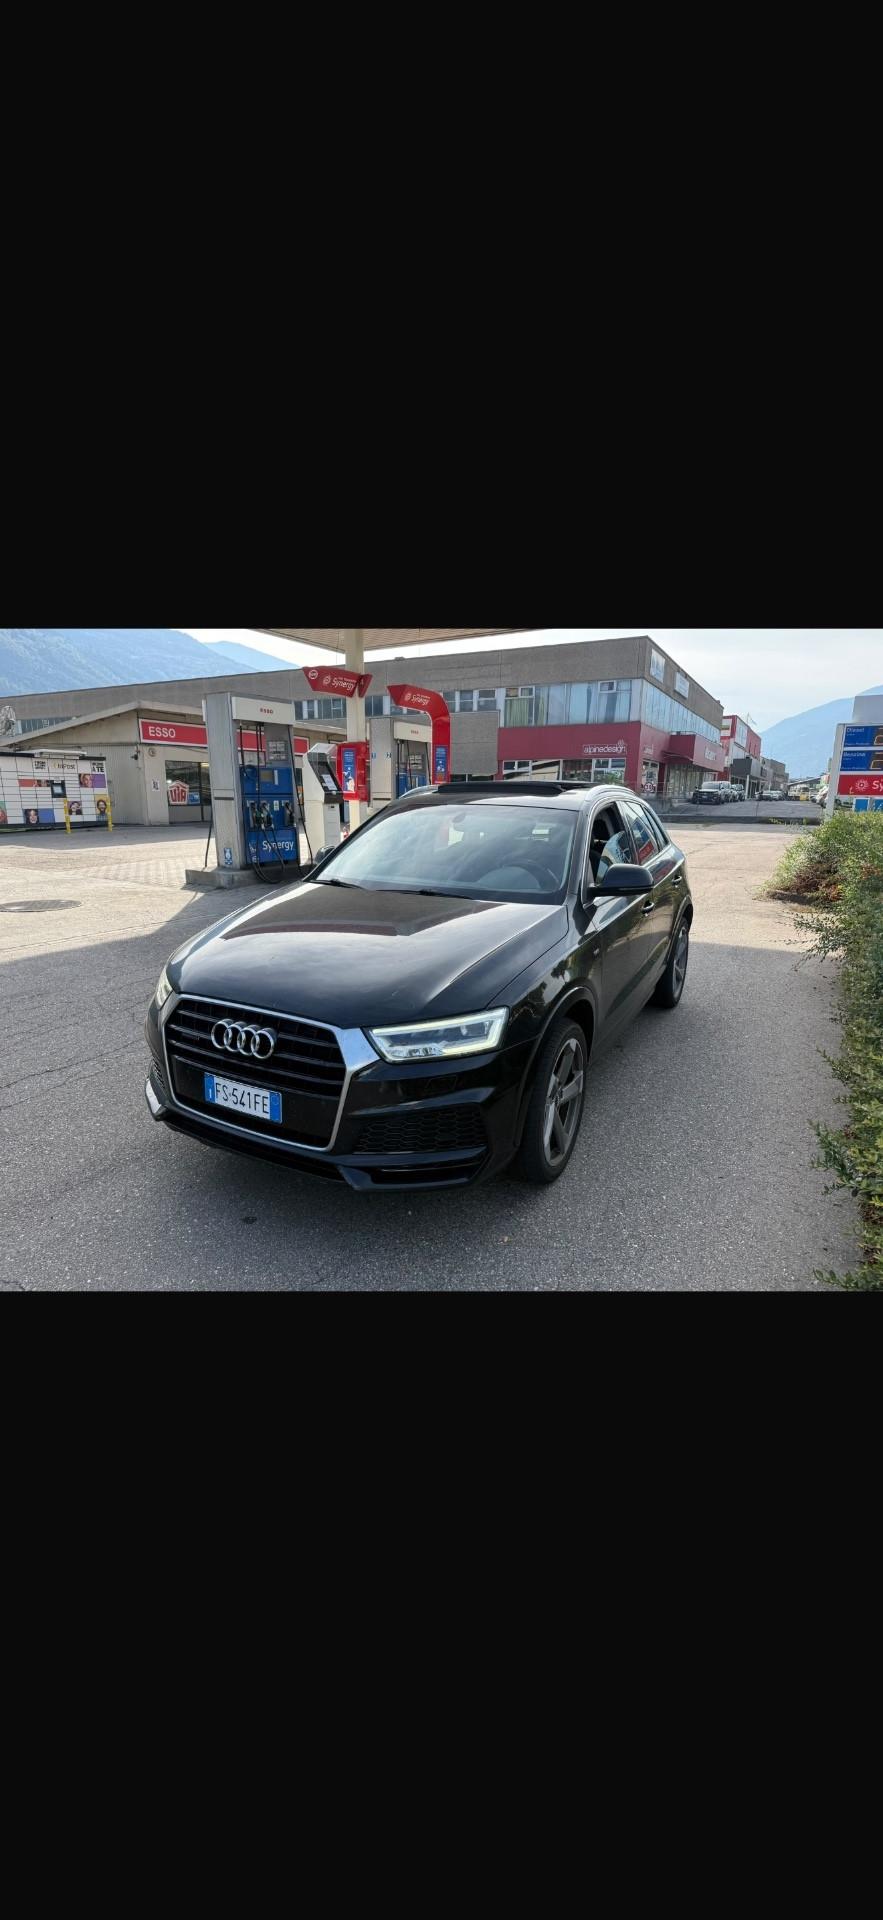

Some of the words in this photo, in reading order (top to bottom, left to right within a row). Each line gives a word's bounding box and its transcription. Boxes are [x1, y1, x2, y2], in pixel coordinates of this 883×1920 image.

[332, 677, 355, 692] Synergy
[148, 726, 175, 738] ESSO
[262, 840, 294, 853] Synergy
